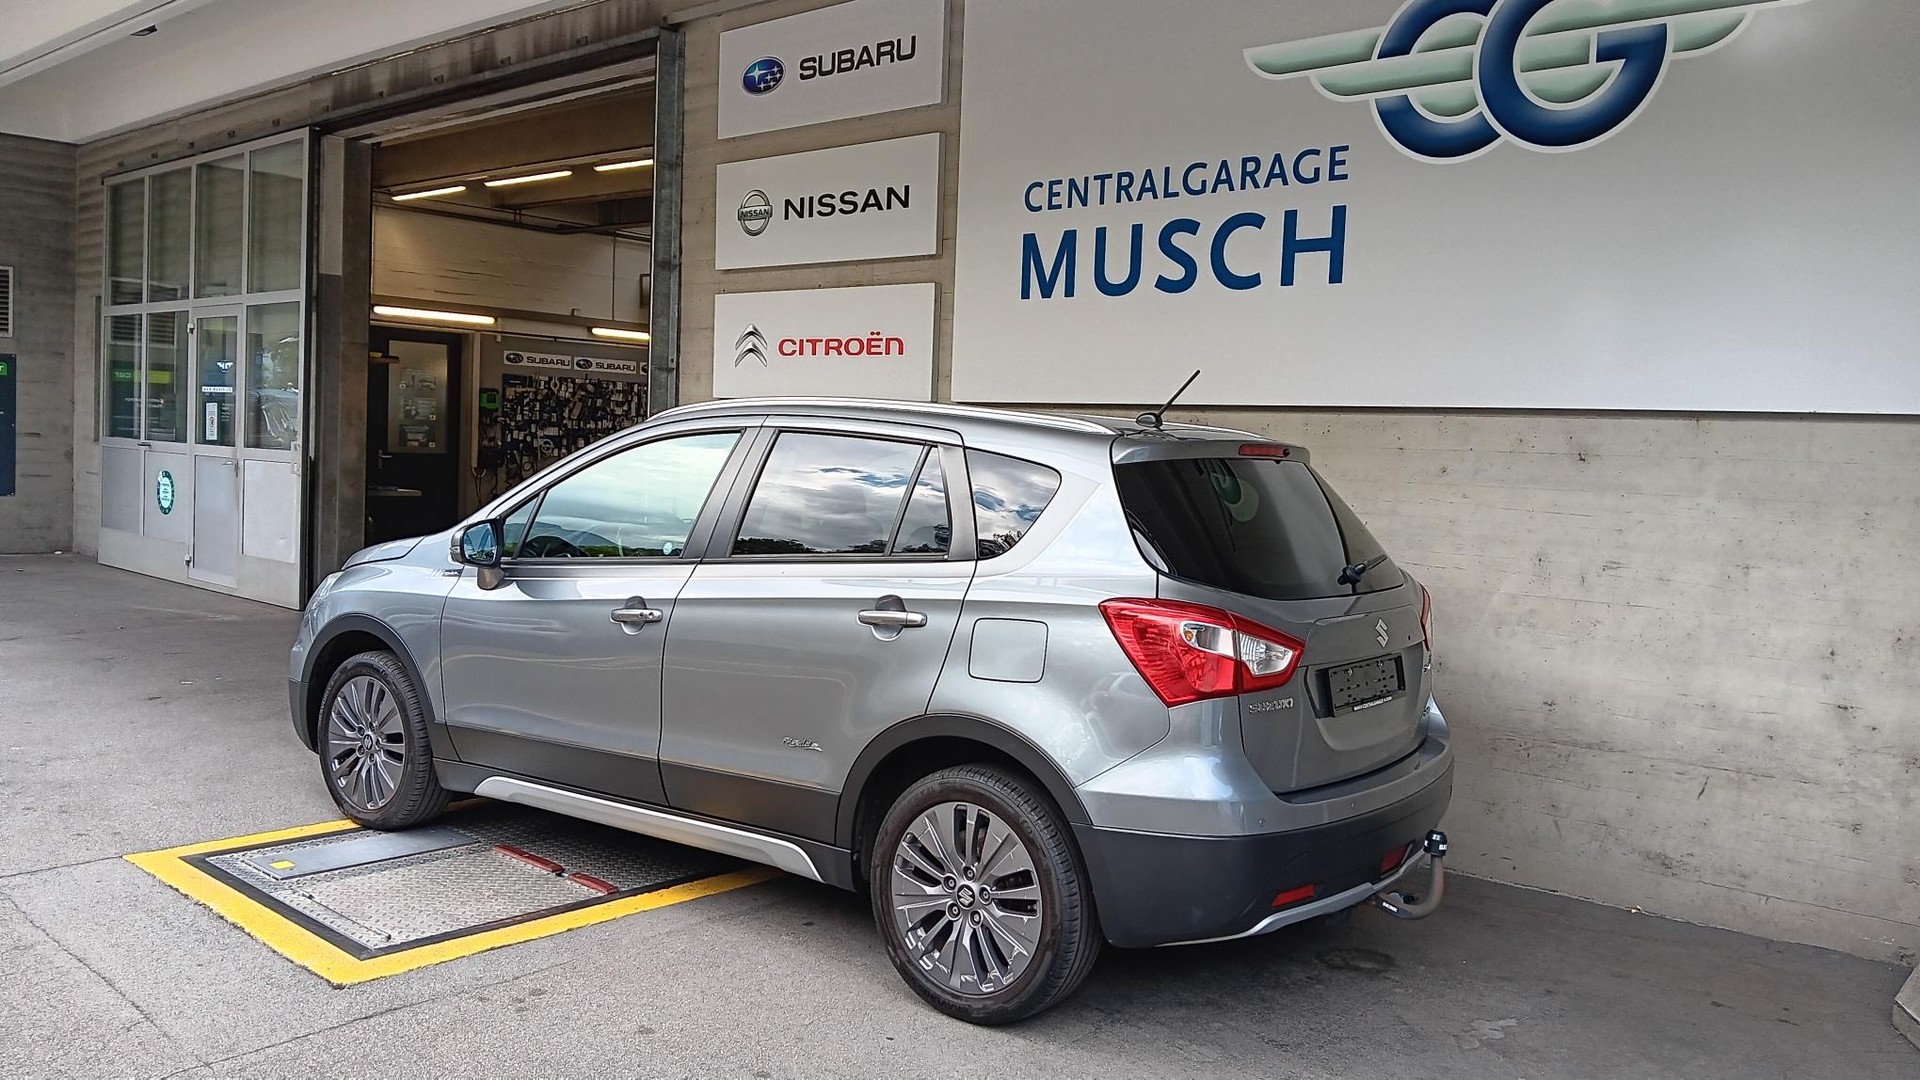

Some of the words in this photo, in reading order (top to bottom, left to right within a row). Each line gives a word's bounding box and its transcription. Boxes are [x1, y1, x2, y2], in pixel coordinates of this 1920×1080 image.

[799, 35, 917, 81] SUBARU
[1024, 145, 1349, 213] CENTRALGARAGE
[740, 208, 771, 219] NISSAN
[784, 184, 910, 220] NISSAN
[1020, 204, 1347, 300] MUSCH
[526, 355, 571, 367] SUBARU
[595, 361, 636, 372] SUBARU
